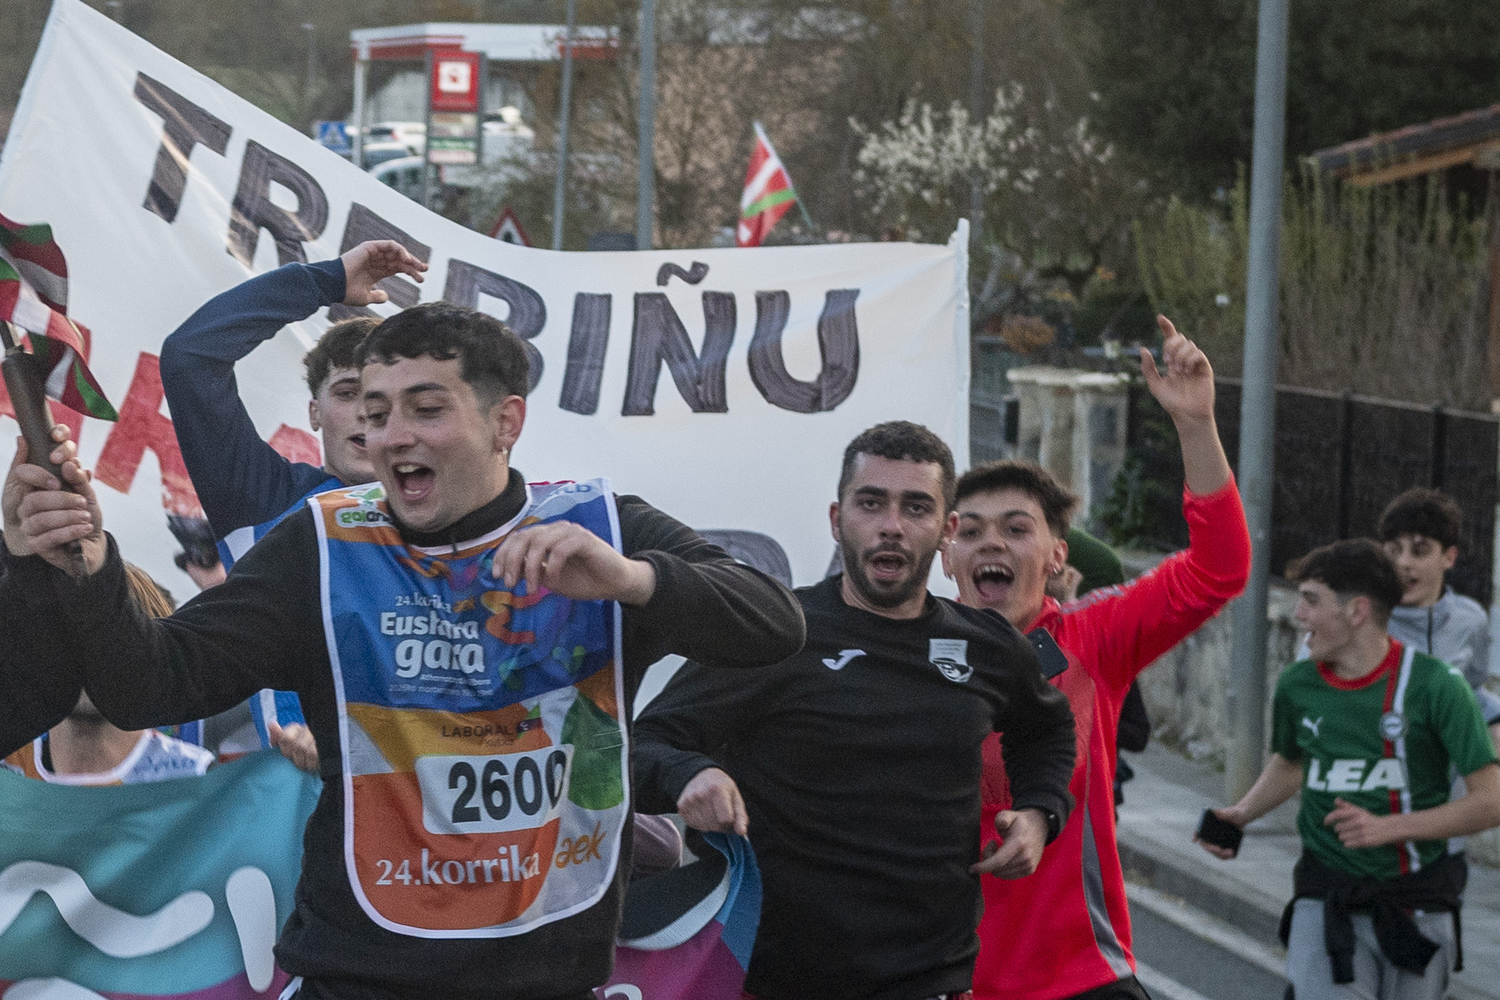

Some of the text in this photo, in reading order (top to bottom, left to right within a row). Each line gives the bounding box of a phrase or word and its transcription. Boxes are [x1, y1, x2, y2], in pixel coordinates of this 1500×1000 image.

[380, 610, 479, 640] Euskara
[395, 638, 486, 678] gara
[442, 724, 514, 738] LABORAL
[448, 750, 566, 824] 2600
[1307, 758, 1405, 791] LEA
[375, 820, 608, 886] 24.korrika aek
